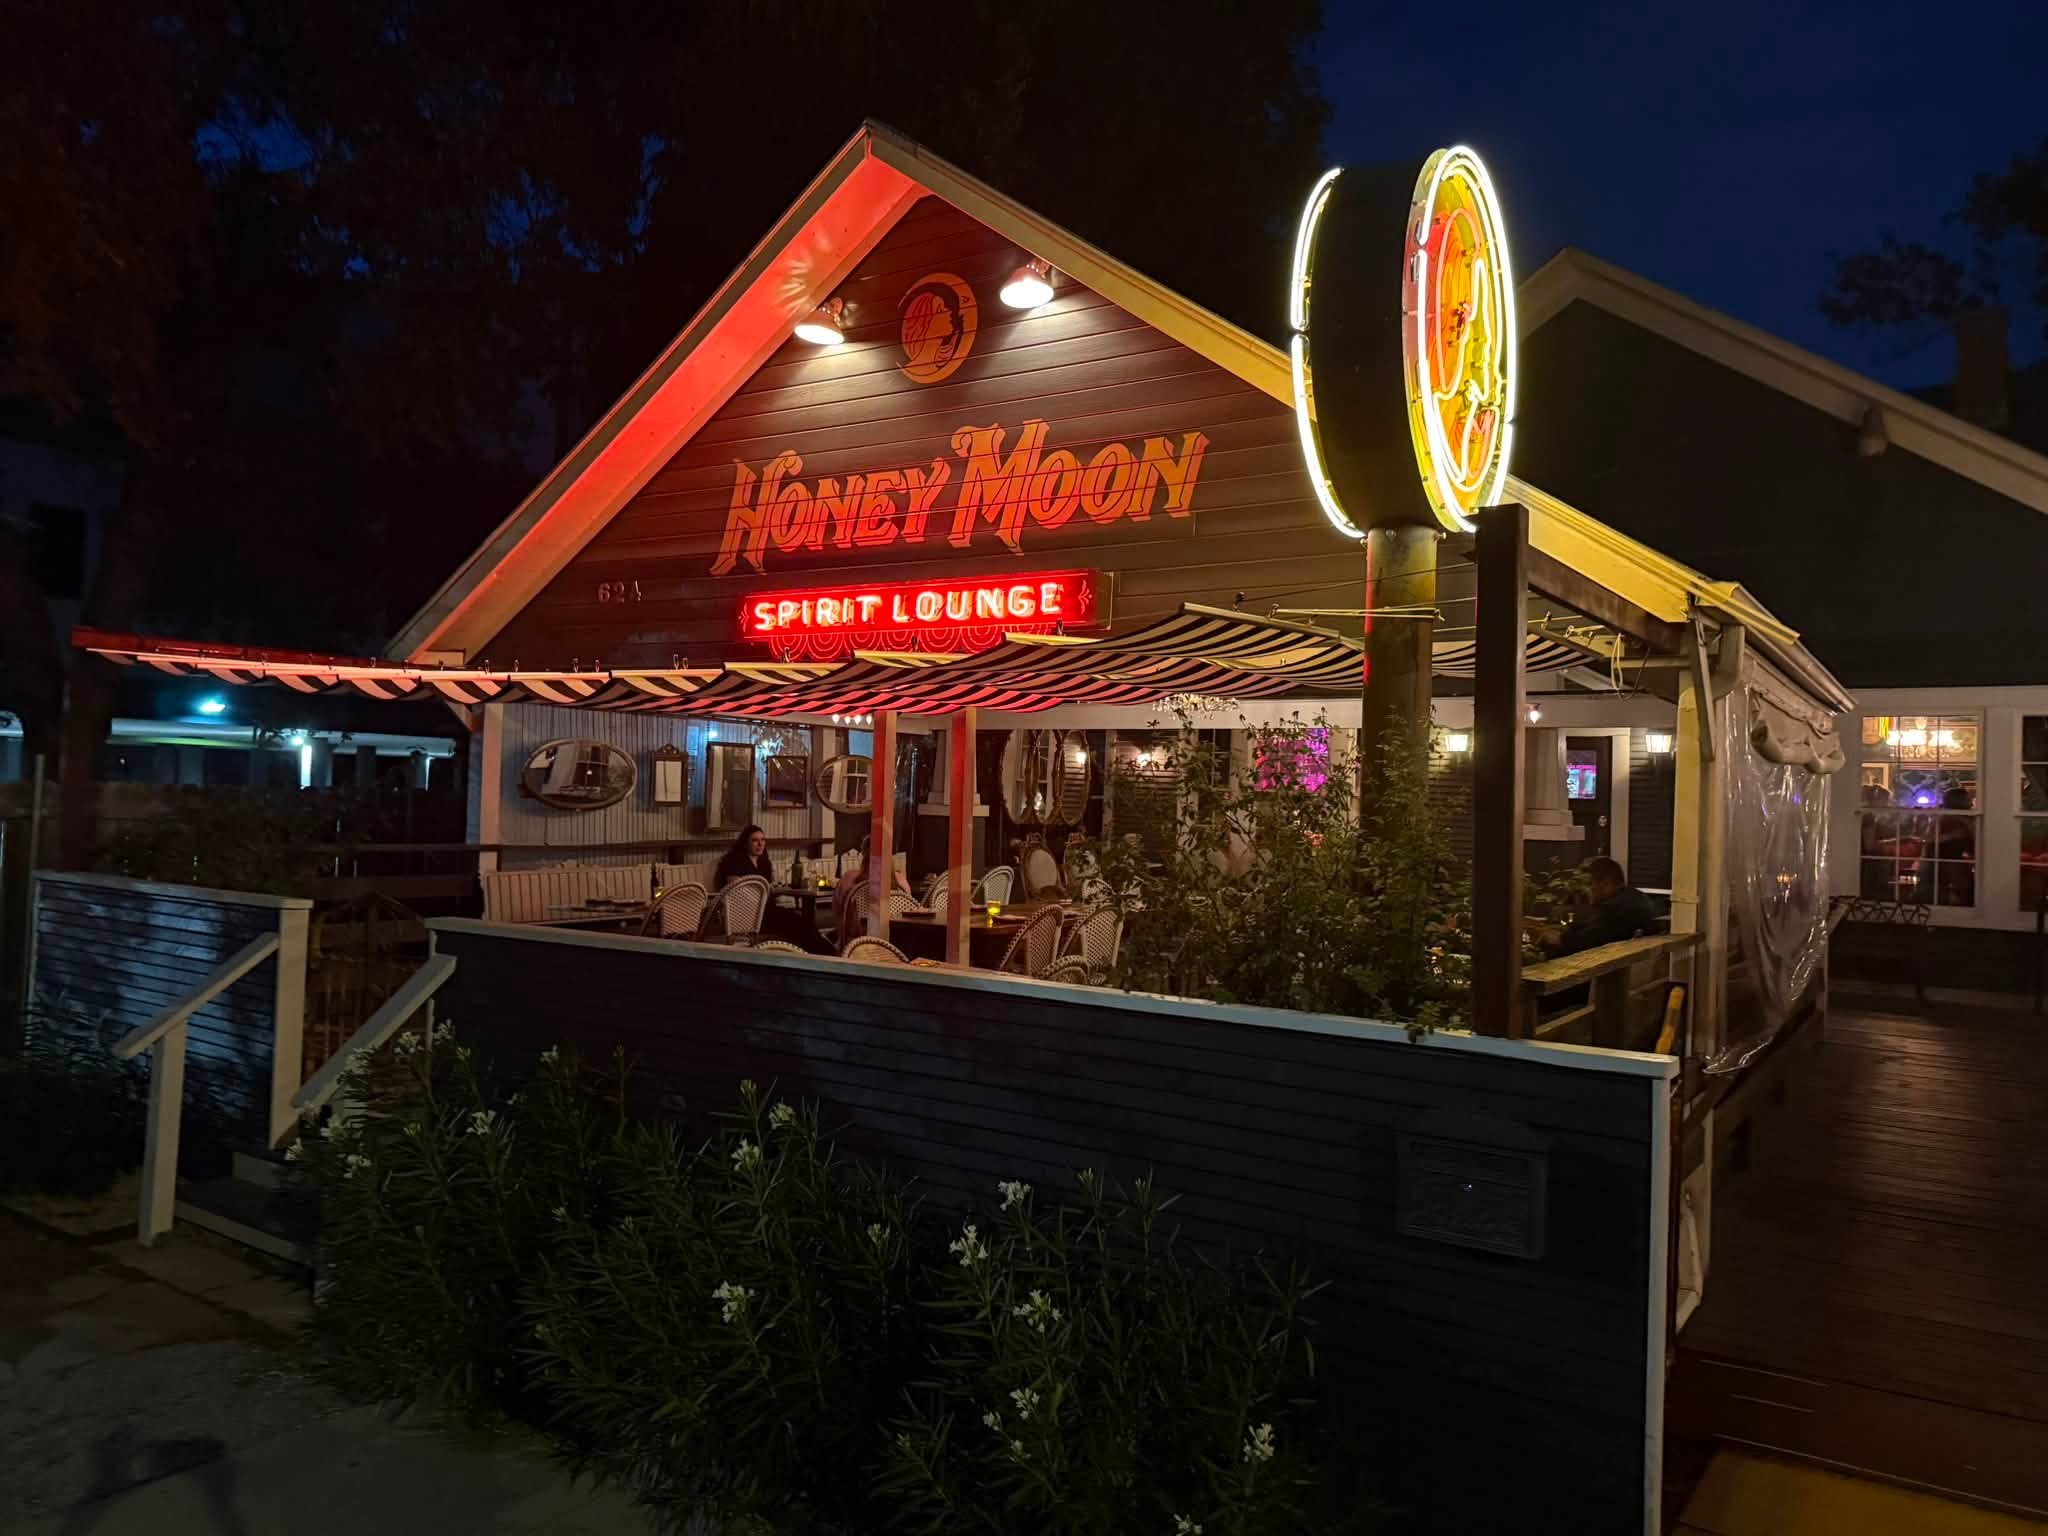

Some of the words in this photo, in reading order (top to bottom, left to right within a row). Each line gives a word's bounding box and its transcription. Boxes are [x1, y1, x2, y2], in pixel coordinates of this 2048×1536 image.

[710, 449, 950, 575] HONEY
[949, 419, 1209, 555] MOON
[753, 595, 882, 631] SPIRIT
[892, 581, 1064, 624] LOUNGE
